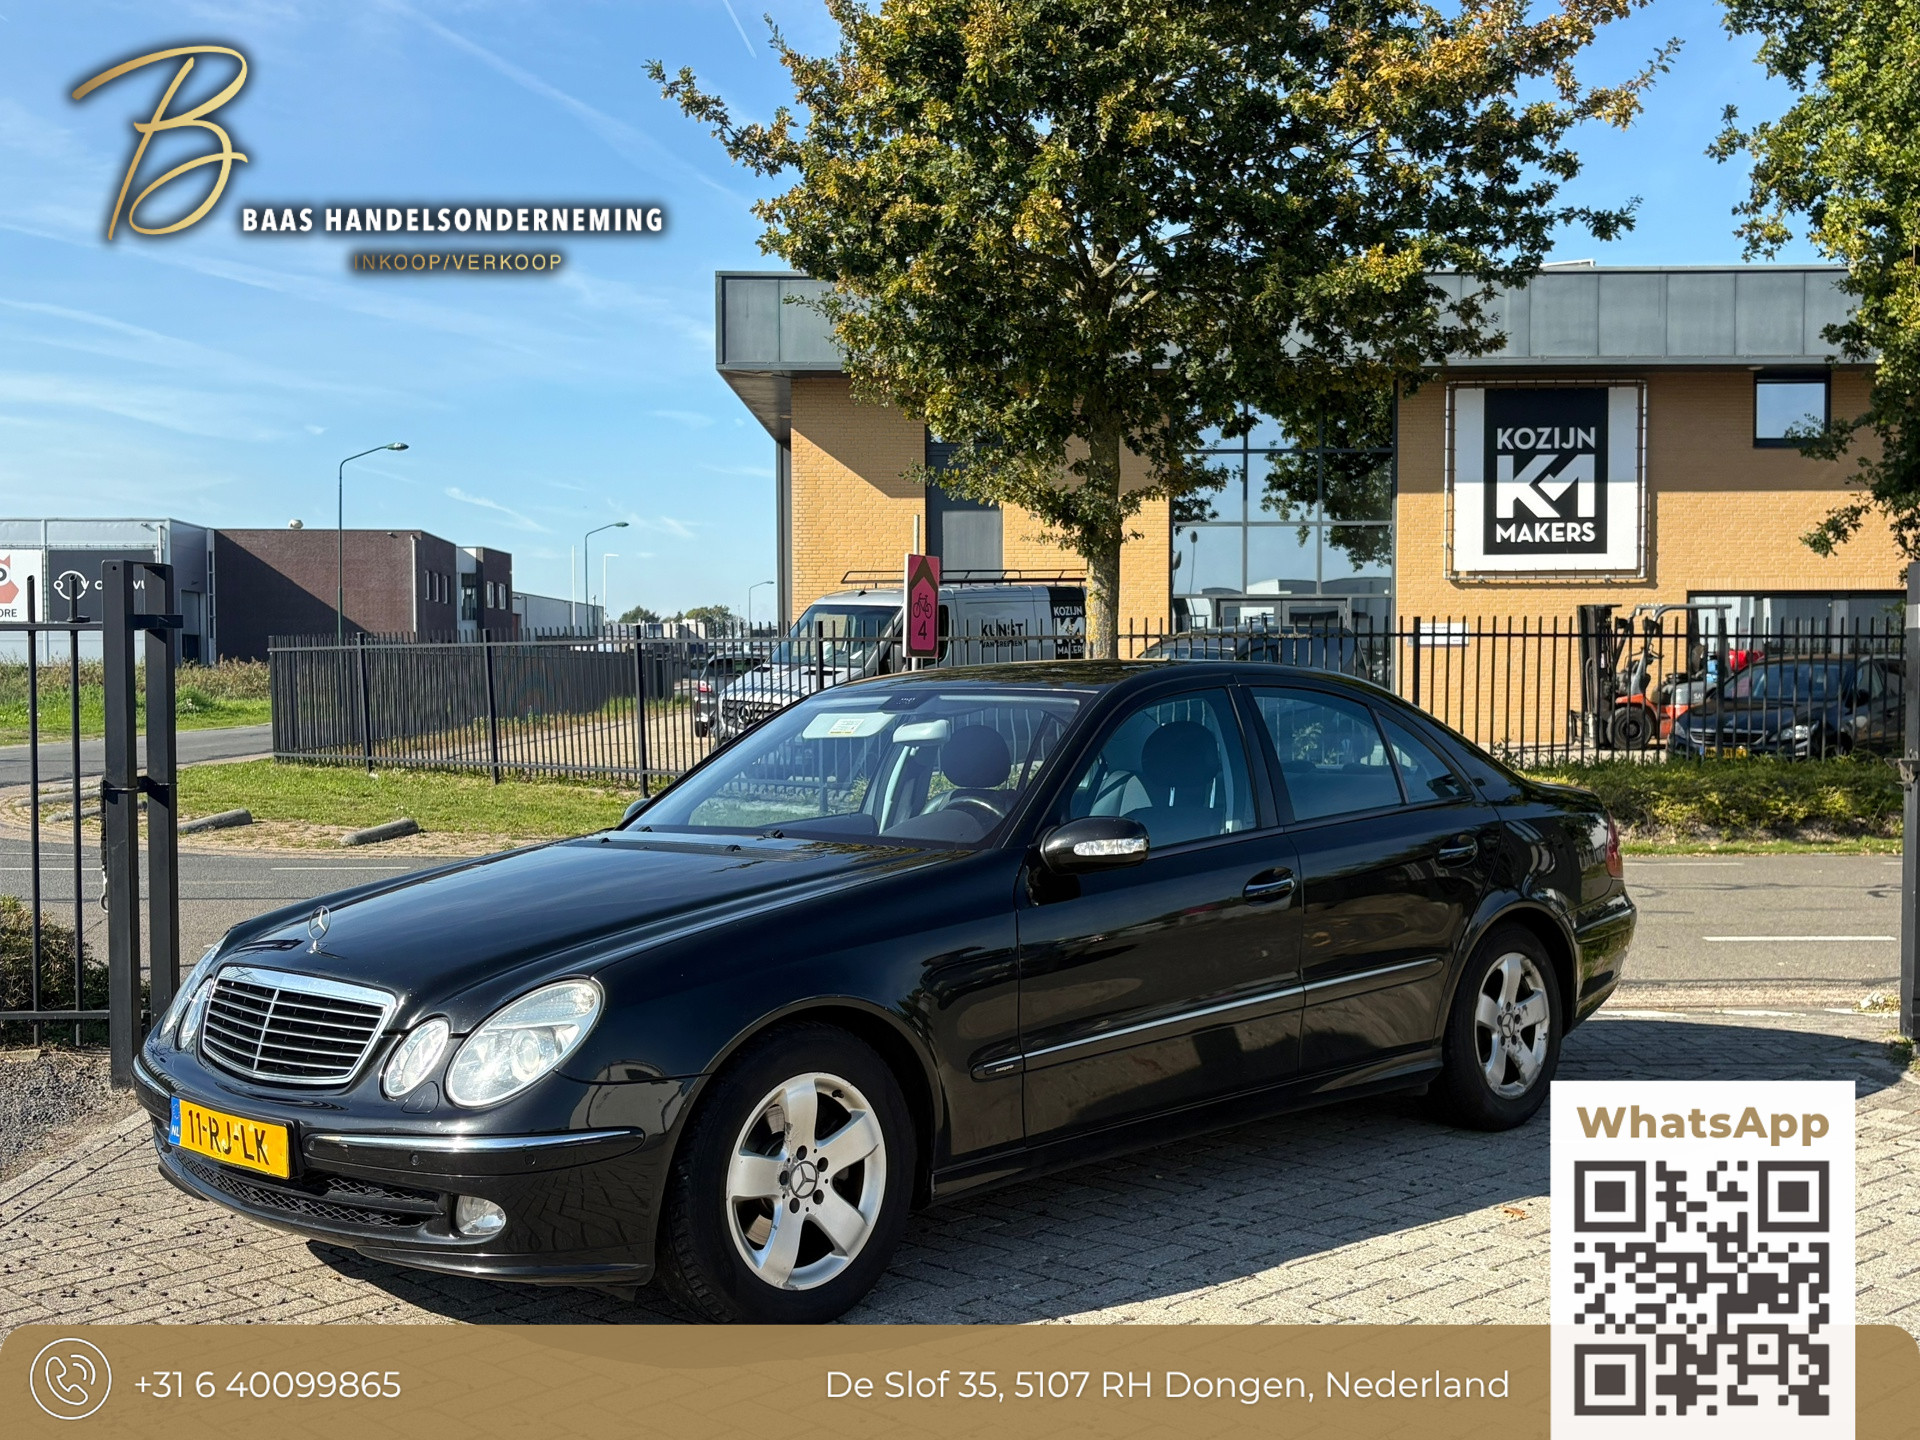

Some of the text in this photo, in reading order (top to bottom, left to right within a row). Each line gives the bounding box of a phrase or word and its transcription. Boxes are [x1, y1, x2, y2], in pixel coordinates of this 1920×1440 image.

[1496, 427, 1596, 450] KOZIJN
[1496, 522, 1596, 543] MAKERS
[1053, 605, 1083, 616] KOZIJN
[917, 620, 928, 640] 4
[171, 1124, 180, 1137] NL
[188, 1109, 270, 1166] 11-RJ-LK
